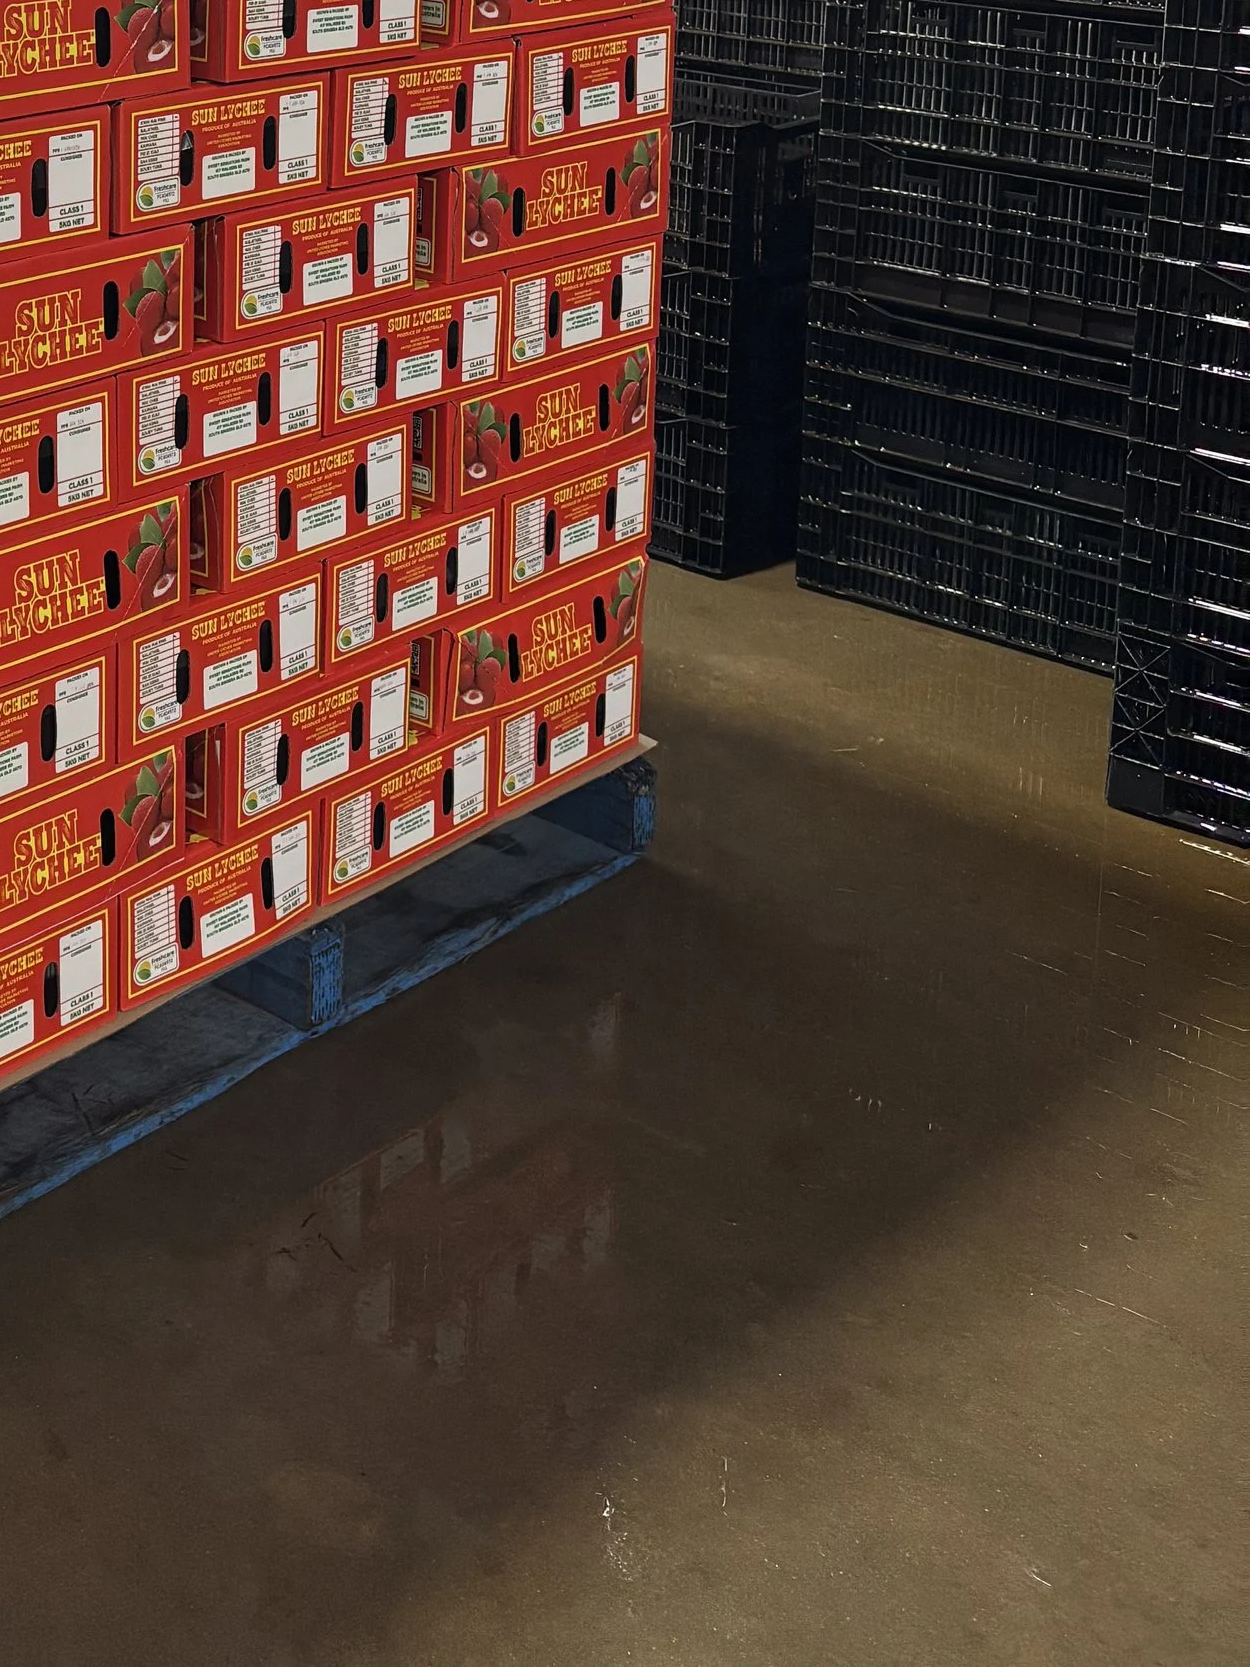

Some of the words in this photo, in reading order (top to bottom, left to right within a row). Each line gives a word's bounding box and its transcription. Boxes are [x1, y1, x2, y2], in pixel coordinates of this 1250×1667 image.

[192, 106, 217, 126] SUN
[220, 97, 265, 122] LYCHEE
[59, 219, 71, 228] 5KG
[72, 217, 84, 226] NET
[60, 205, 79, 216] CLASS
[16, 288, 81, 338] SUN
[536, 383, 581, 421] SUN
[523, 405, 595, 456] LYCHEE
[381, 774, 403, 798] SUN
[405, 754, 442, 787] LYCHEE
[13, 809, 80, 869] SUN
[70, 1008, 81, 1020] 5KG
[83, 1002, 94, 1014] NET
[71, 993, 89, 1008] CLASS
